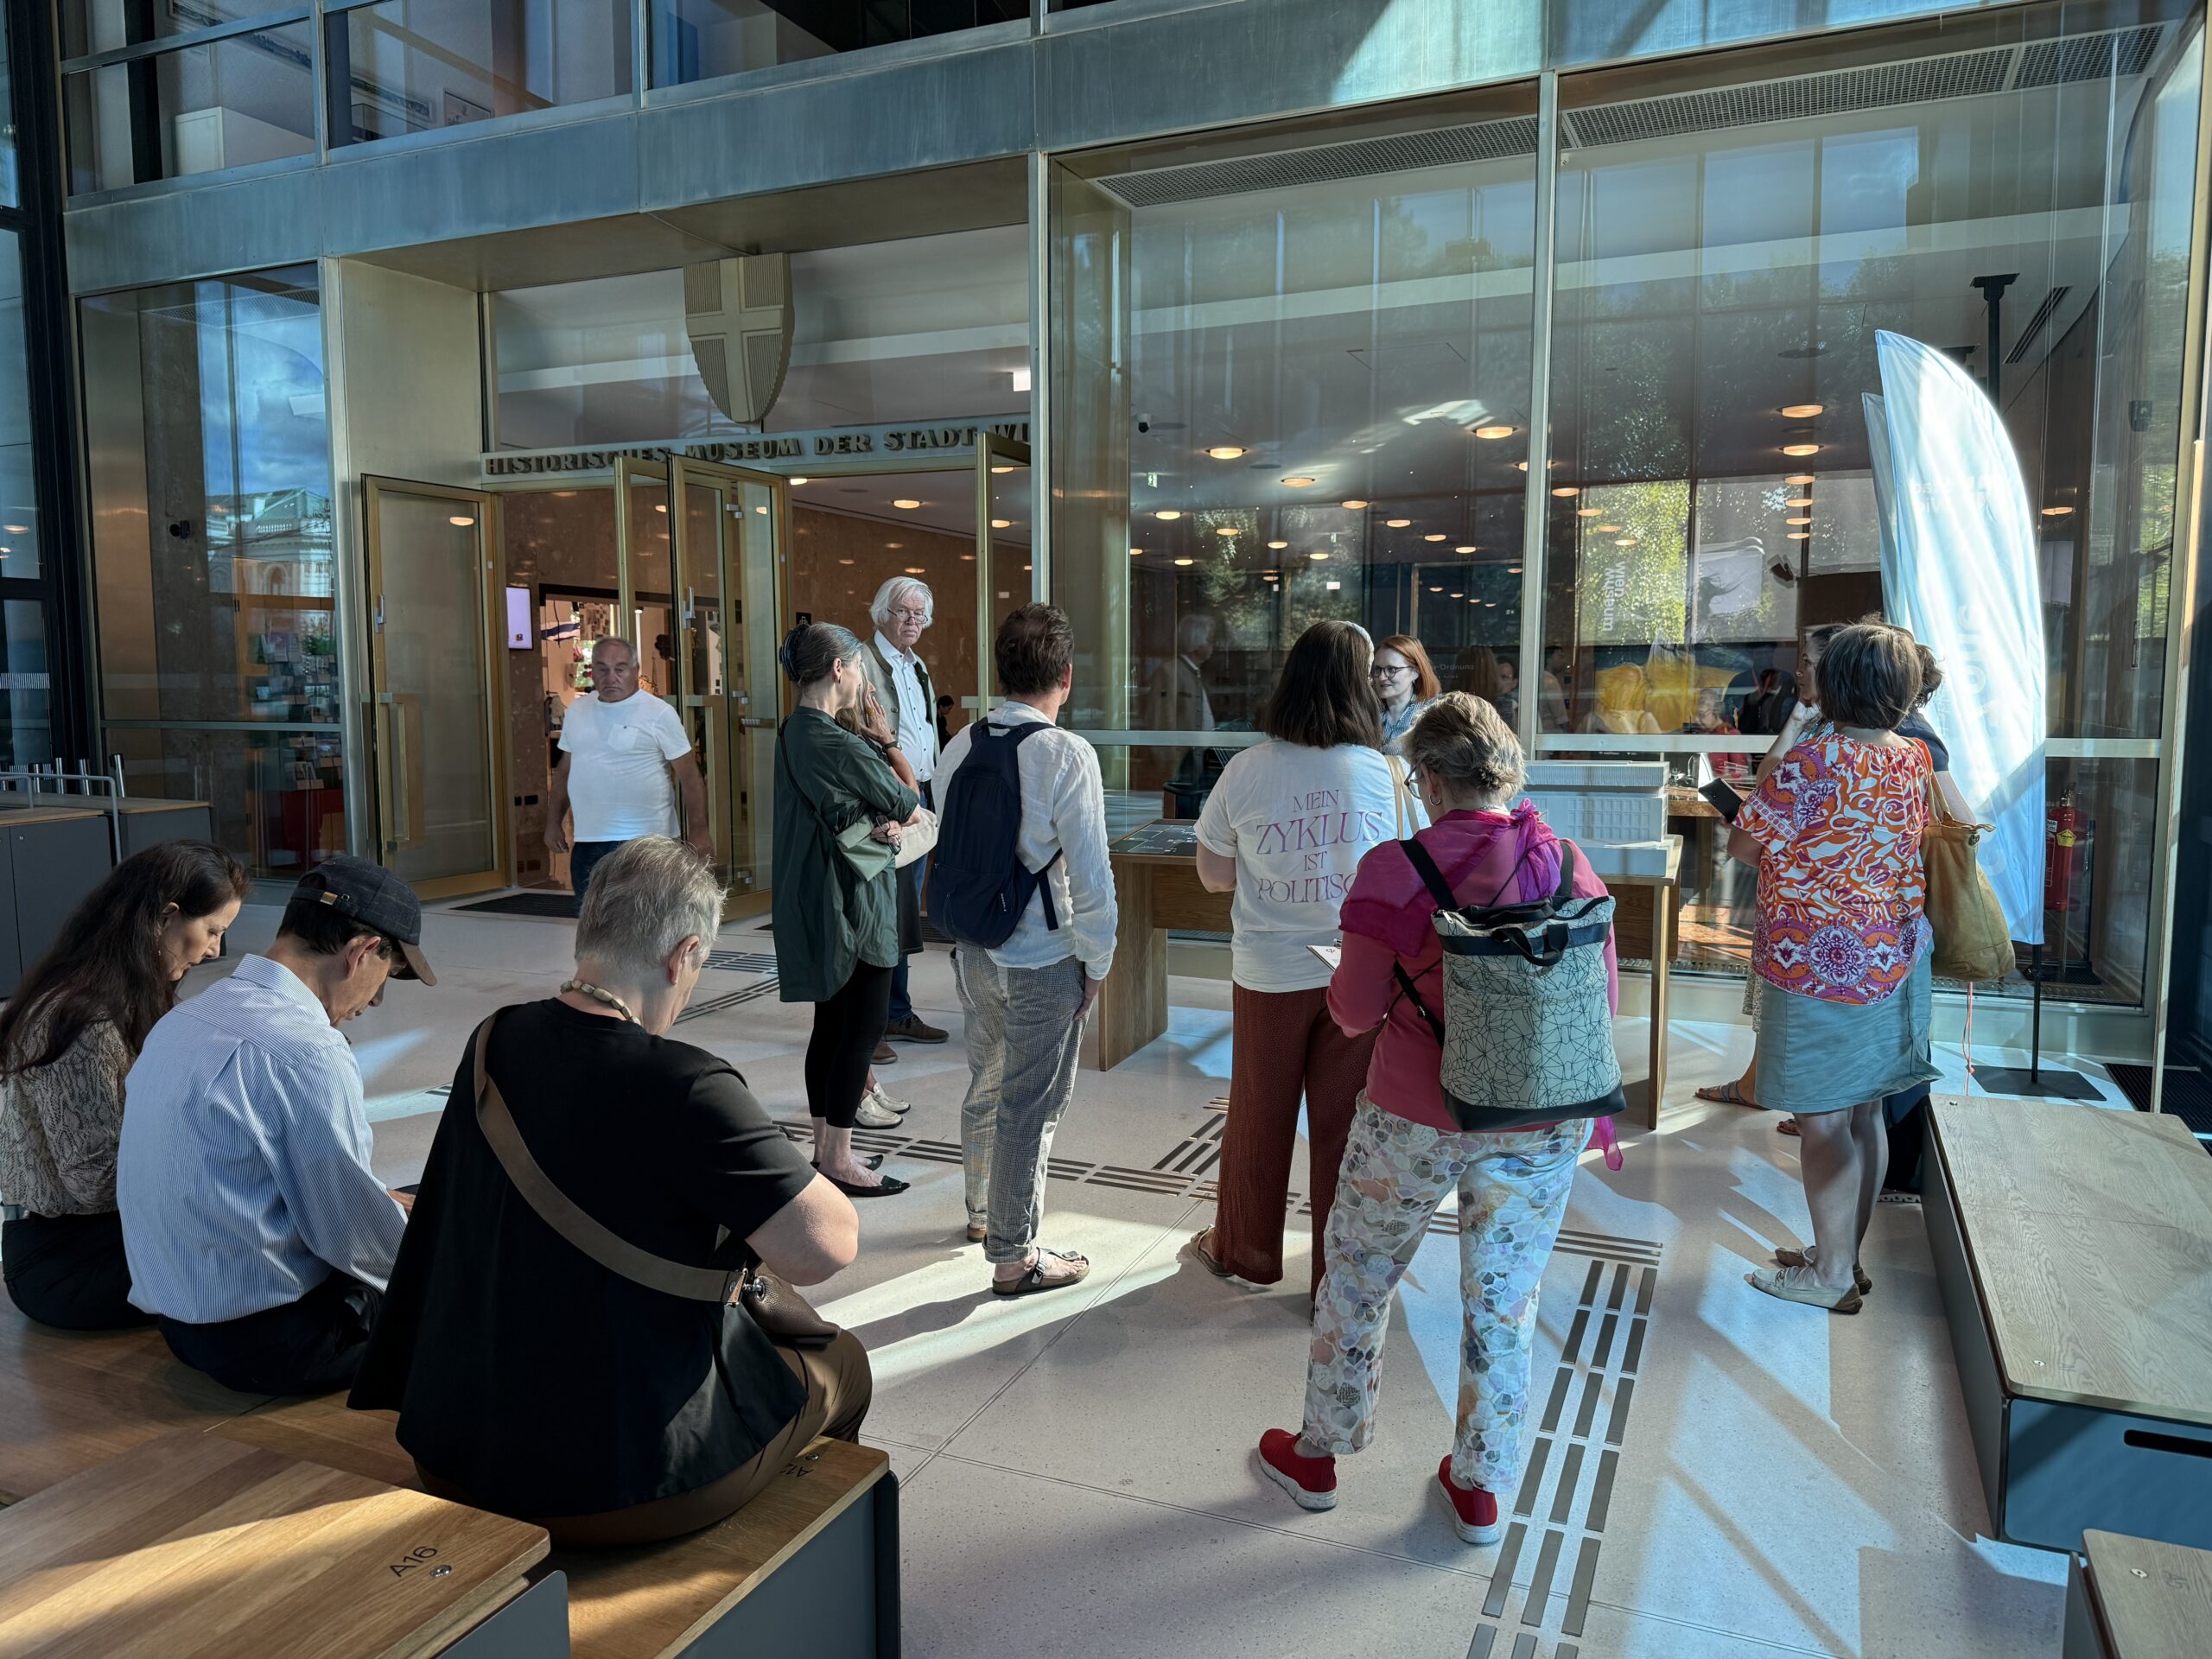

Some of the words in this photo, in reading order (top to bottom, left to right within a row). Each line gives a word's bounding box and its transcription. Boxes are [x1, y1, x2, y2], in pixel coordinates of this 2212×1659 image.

[684, 438, 804, 461] MUSEUM
[814, 434, 873, 455] DER
[883, 426, 978, 452] STADT
[988, 423, 1031, 442] WI
[1293, 789, 1339, 813] MEIN
[1255, 810, 1382, 855] ZYKLUS
[1303, 850, 1328, 872] IST
[1257, 873, 1358, 904] POLITISC
[390, 1546, 438, 1578] A16
